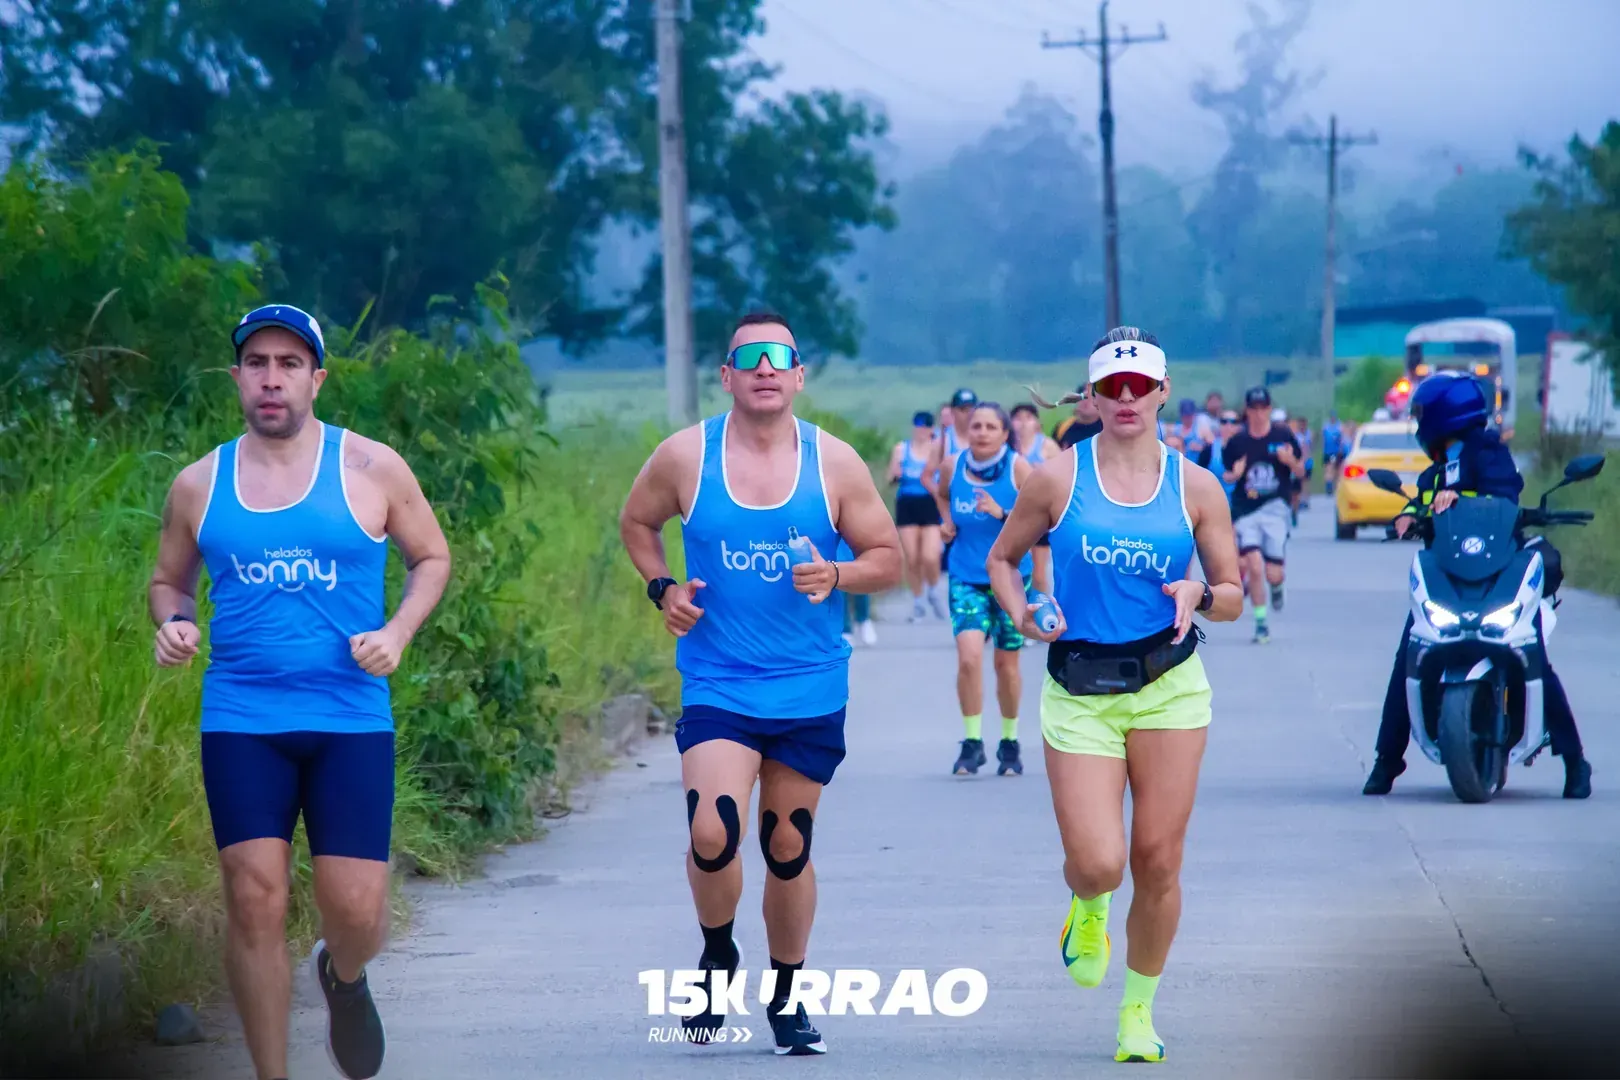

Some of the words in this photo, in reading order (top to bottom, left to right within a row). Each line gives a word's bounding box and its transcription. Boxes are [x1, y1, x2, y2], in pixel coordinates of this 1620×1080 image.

[264, 545, 313, 560] helados
[720, 540, 790, 571] tonn
[1081, 534, 1171, 579] tonny
[1111, 535, 1154, 551] helados
[230, 553, 338, 592] tonny
